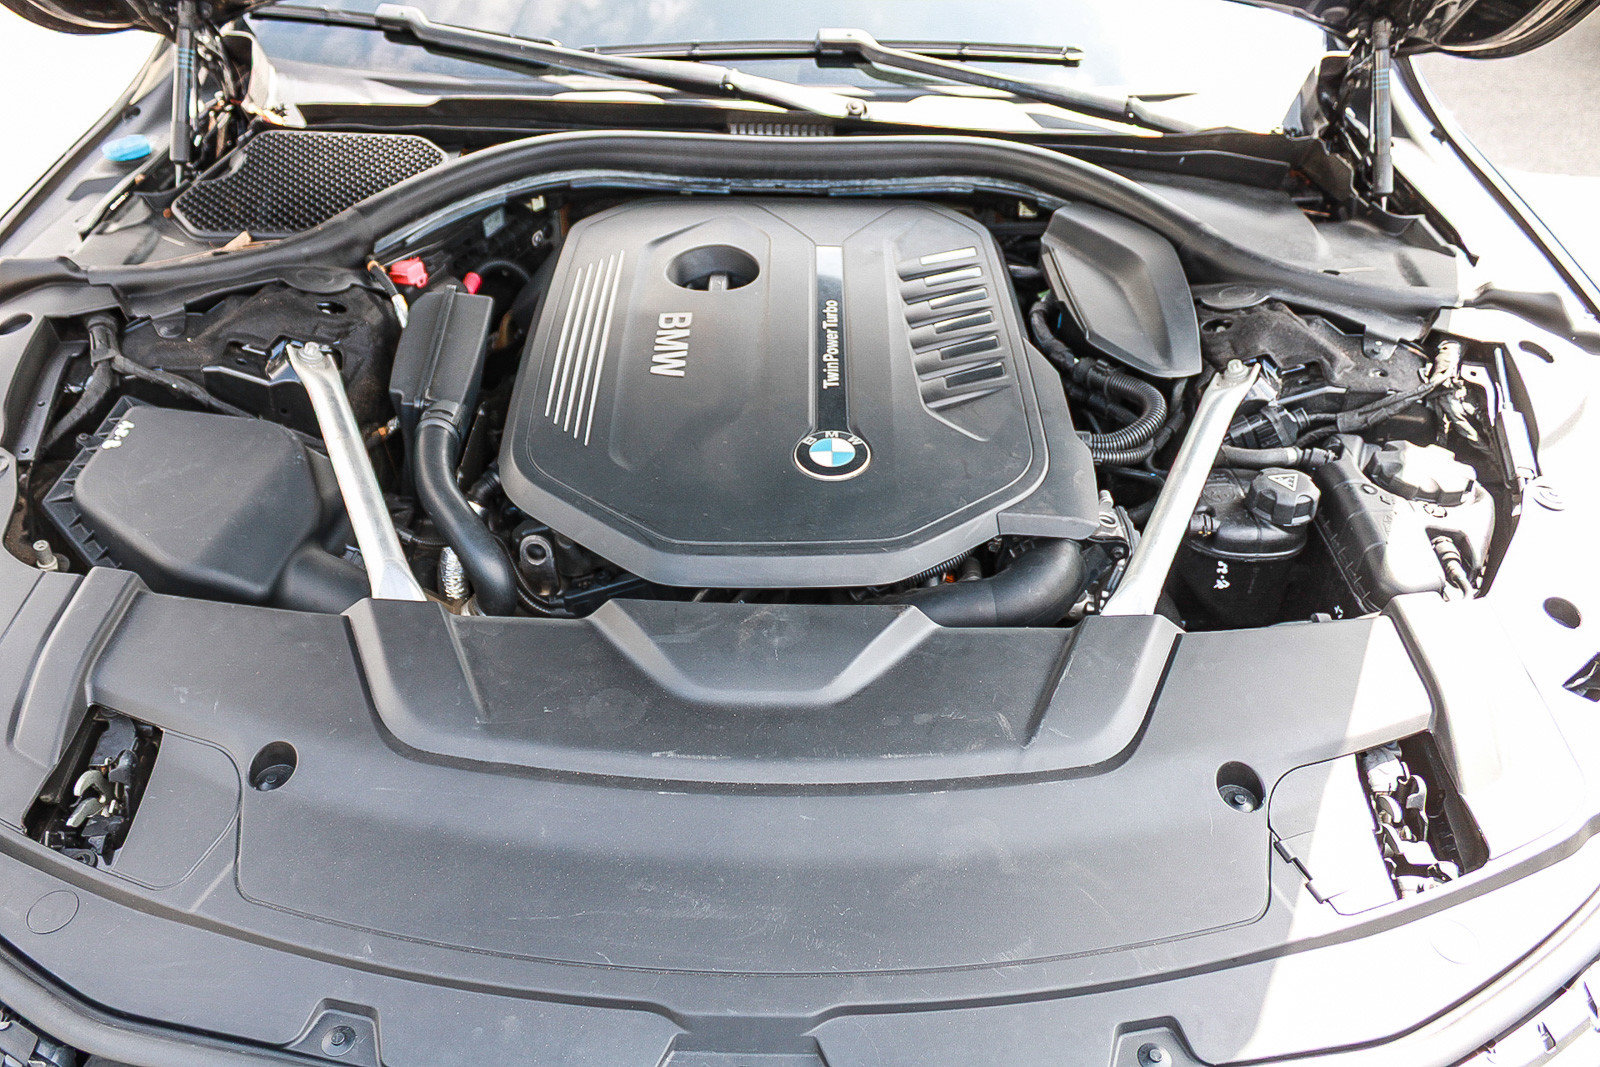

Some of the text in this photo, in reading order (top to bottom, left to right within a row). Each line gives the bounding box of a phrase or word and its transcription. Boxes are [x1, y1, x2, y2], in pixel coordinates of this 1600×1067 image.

[649, 311, 693, 378] BMW
[822, 299, 840, 390] TwinPower Turbo
[802, 430, 864, 446] BMW
